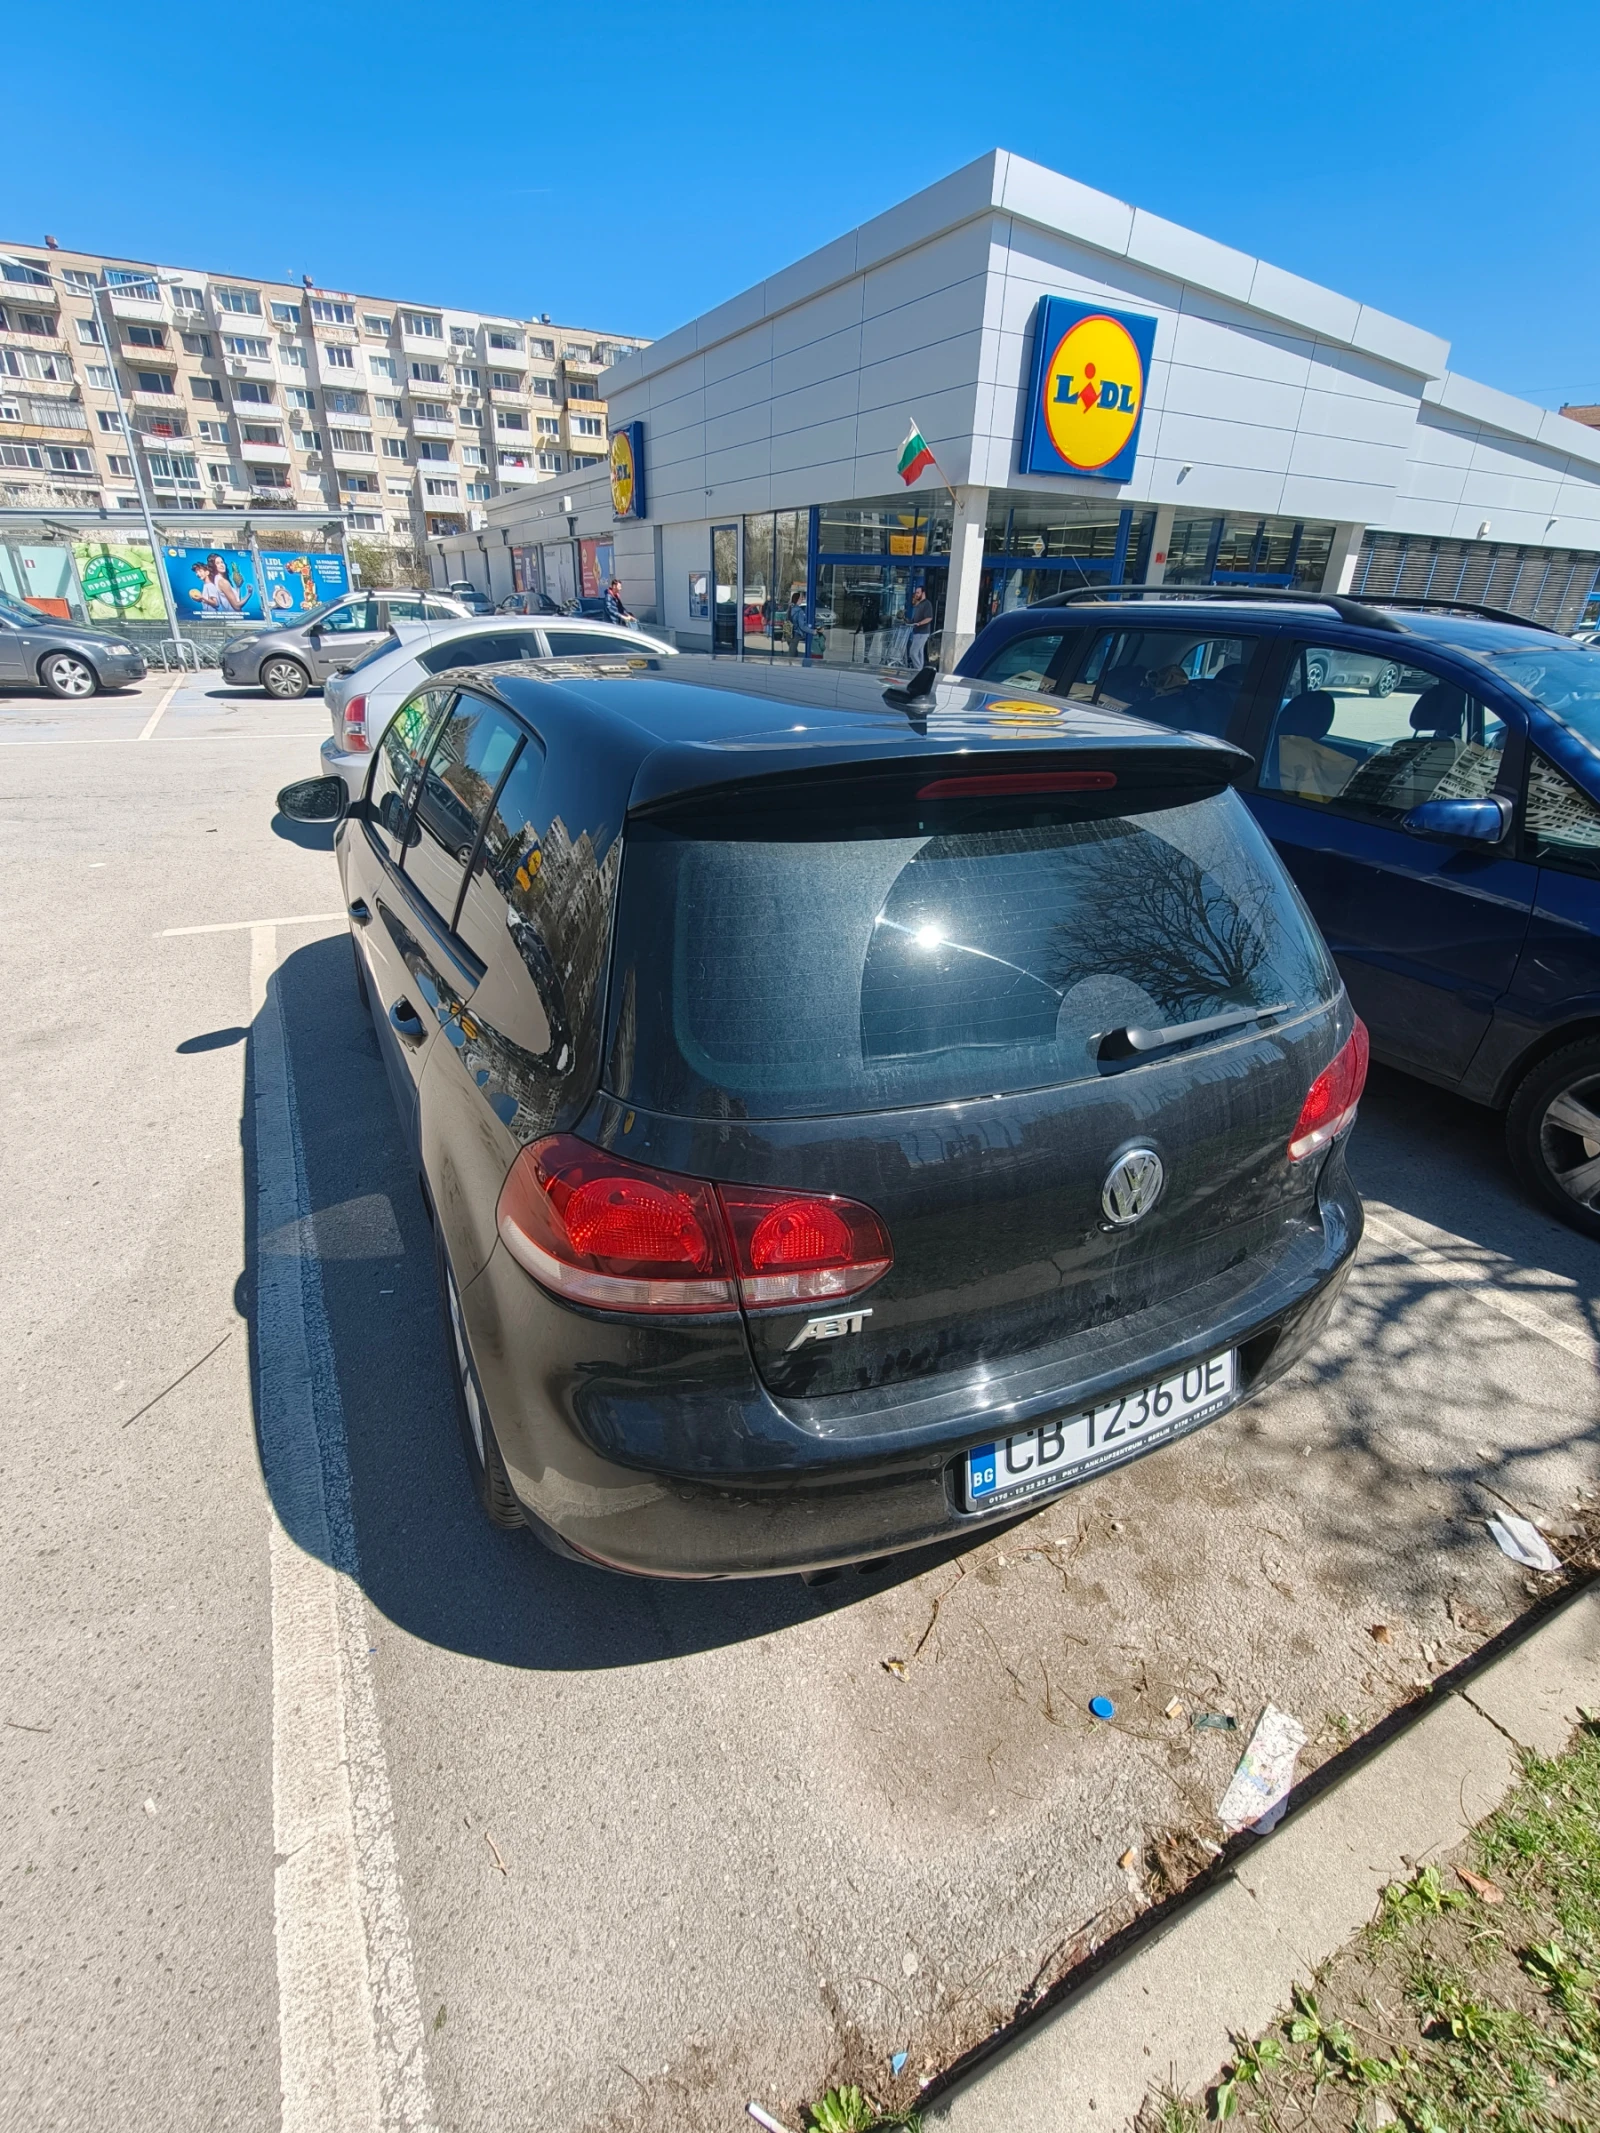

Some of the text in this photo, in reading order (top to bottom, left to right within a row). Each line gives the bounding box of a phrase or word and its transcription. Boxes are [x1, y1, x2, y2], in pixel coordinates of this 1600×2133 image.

[264, 558, 284, 566] LIDL
[87, 573, 139, 591] ПРОВЕРЕНИ
[279, 571, 286, 581] 1
[785, 1308, 873, 1352] ABT
[1005, 1421, 1065, 1475] CB
[1082, 1382, 1173, 1449] 1236
[1062, 1466, 1079, 1478] PKW
[1084, 1440, 1143, 1469] ANKAUFZENTRUM
[1147, 1427, 1170, 1442] BERLIN
[973, 1467, 993, 1488] BG
